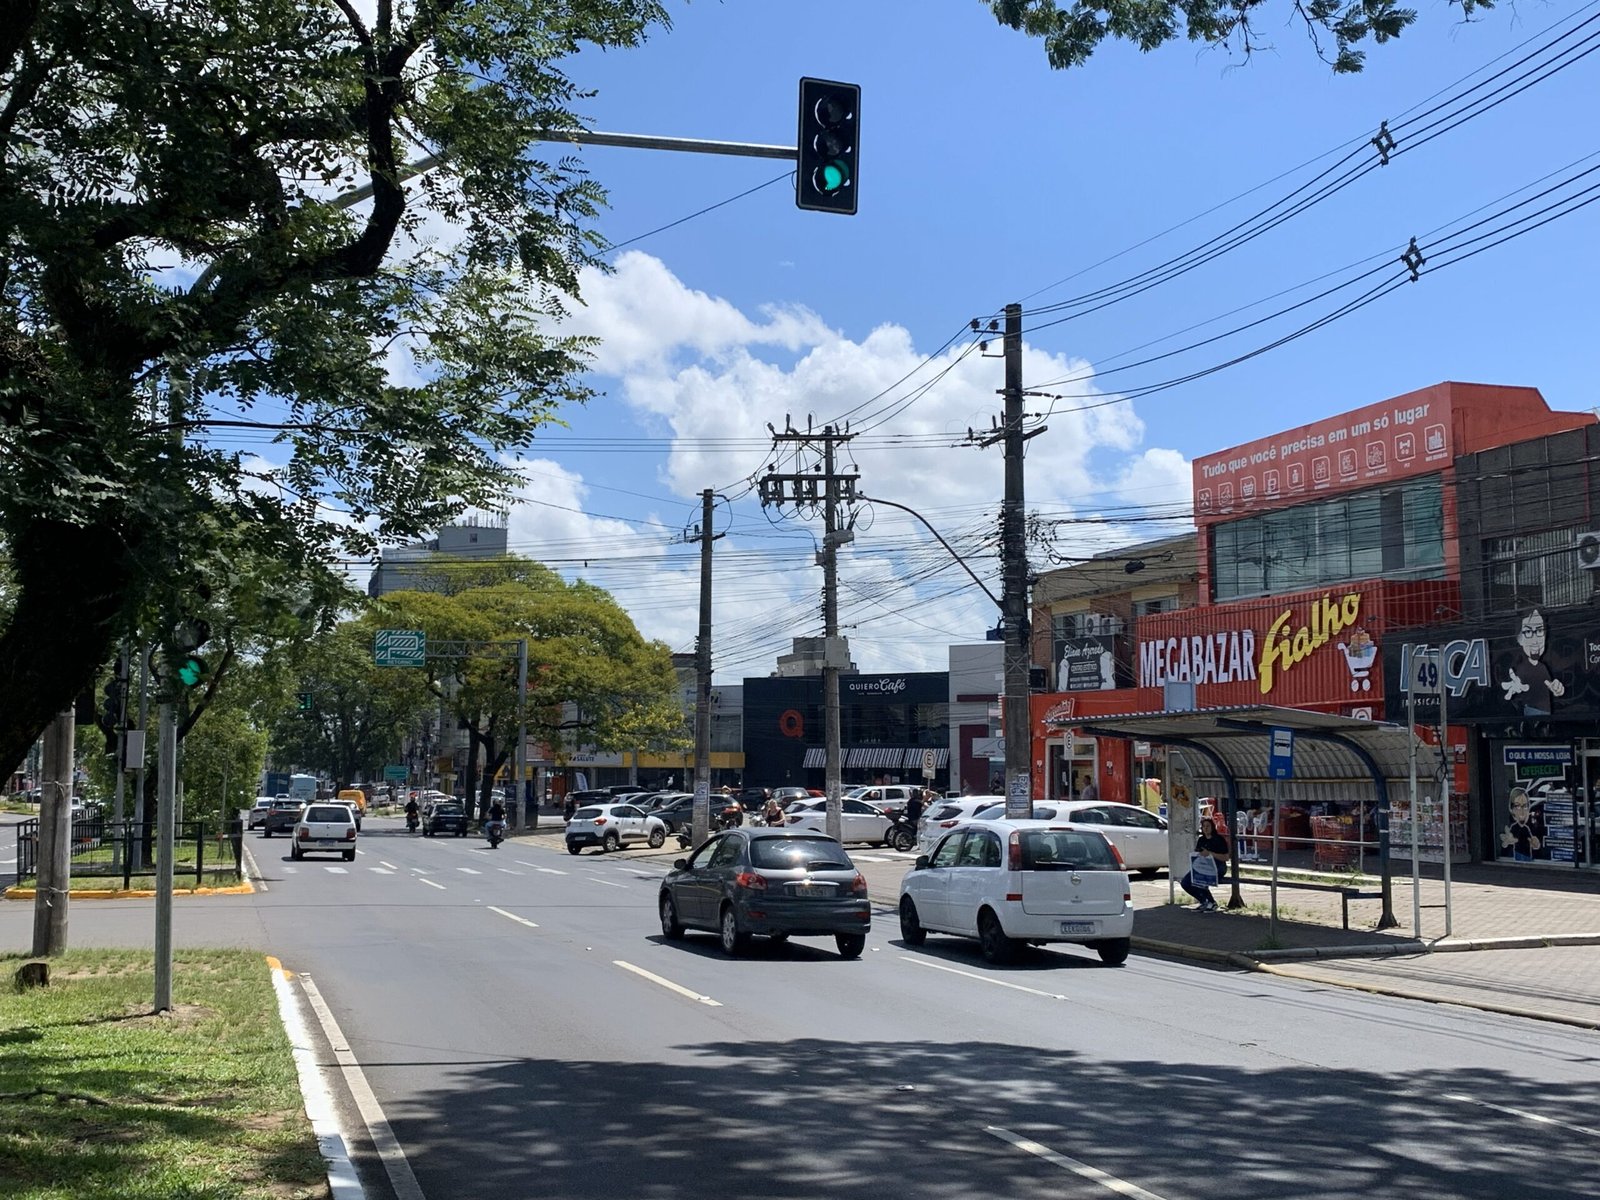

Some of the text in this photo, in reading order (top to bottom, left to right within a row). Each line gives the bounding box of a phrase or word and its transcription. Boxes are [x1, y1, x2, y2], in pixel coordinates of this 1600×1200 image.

[1202, 403, 1430, 479] Tudo que você precisa em um só lugar
[1140, 629, 1256, 688] MEGABAZAR
[849, 683, 879, 691] QUIERO
[879, 678, 906, 694] Café
[1417, 662, 1438, 688] 49
[1514, 751, 1526, 760] QUE
[1527, 751, 1533, 760] A
[1533, 751, 1554, 760] NOSSA
